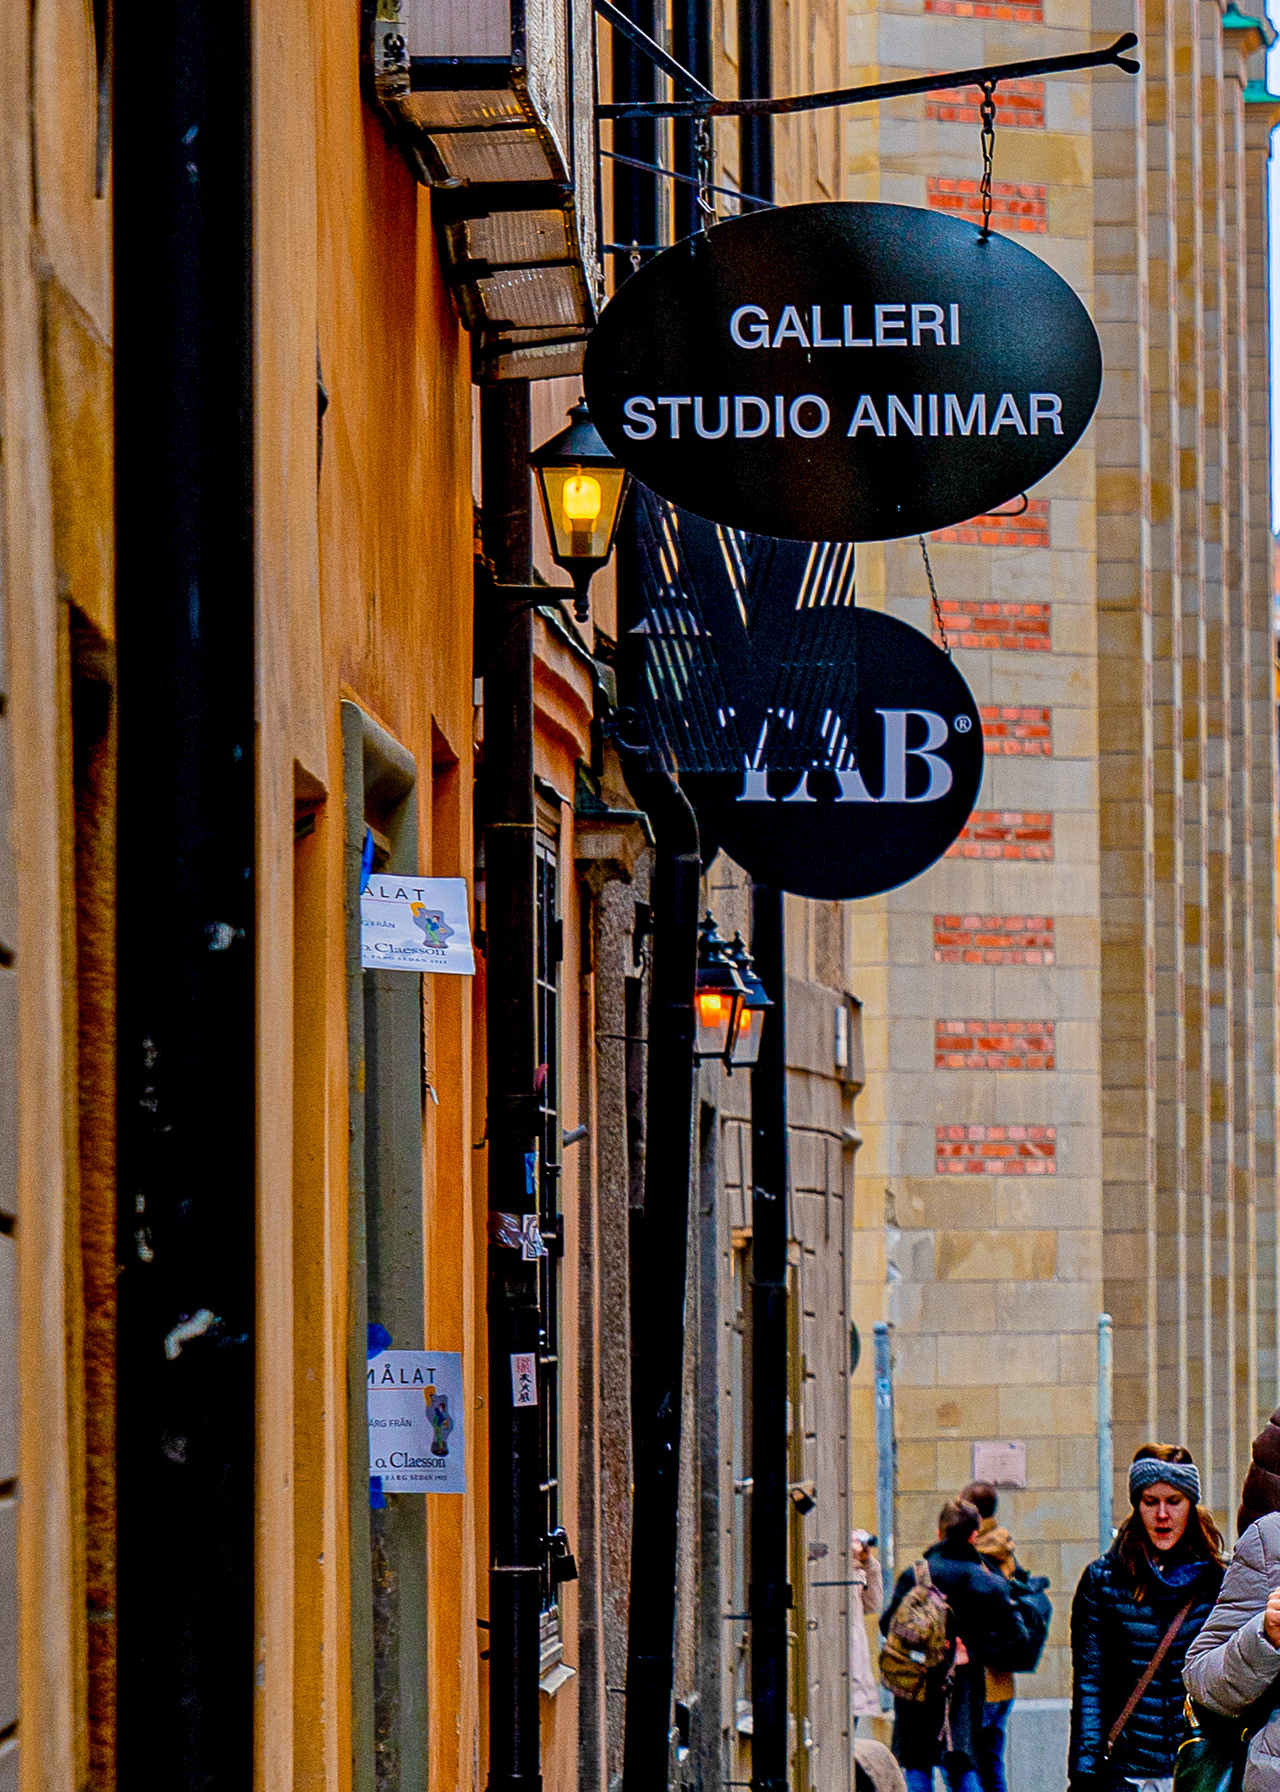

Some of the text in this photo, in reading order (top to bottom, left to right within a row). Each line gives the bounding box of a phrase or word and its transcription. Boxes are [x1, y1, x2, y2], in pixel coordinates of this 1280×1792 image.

[729, 304, 960, 350] GALLERI
[622, 393, 1065, 440] STUDIO ANIMAR
[374, 942, 446, 957] Claesson
[389, 1417, 412, 1428] FRÅN
[389, 1451, 446, 1469] Claesson
